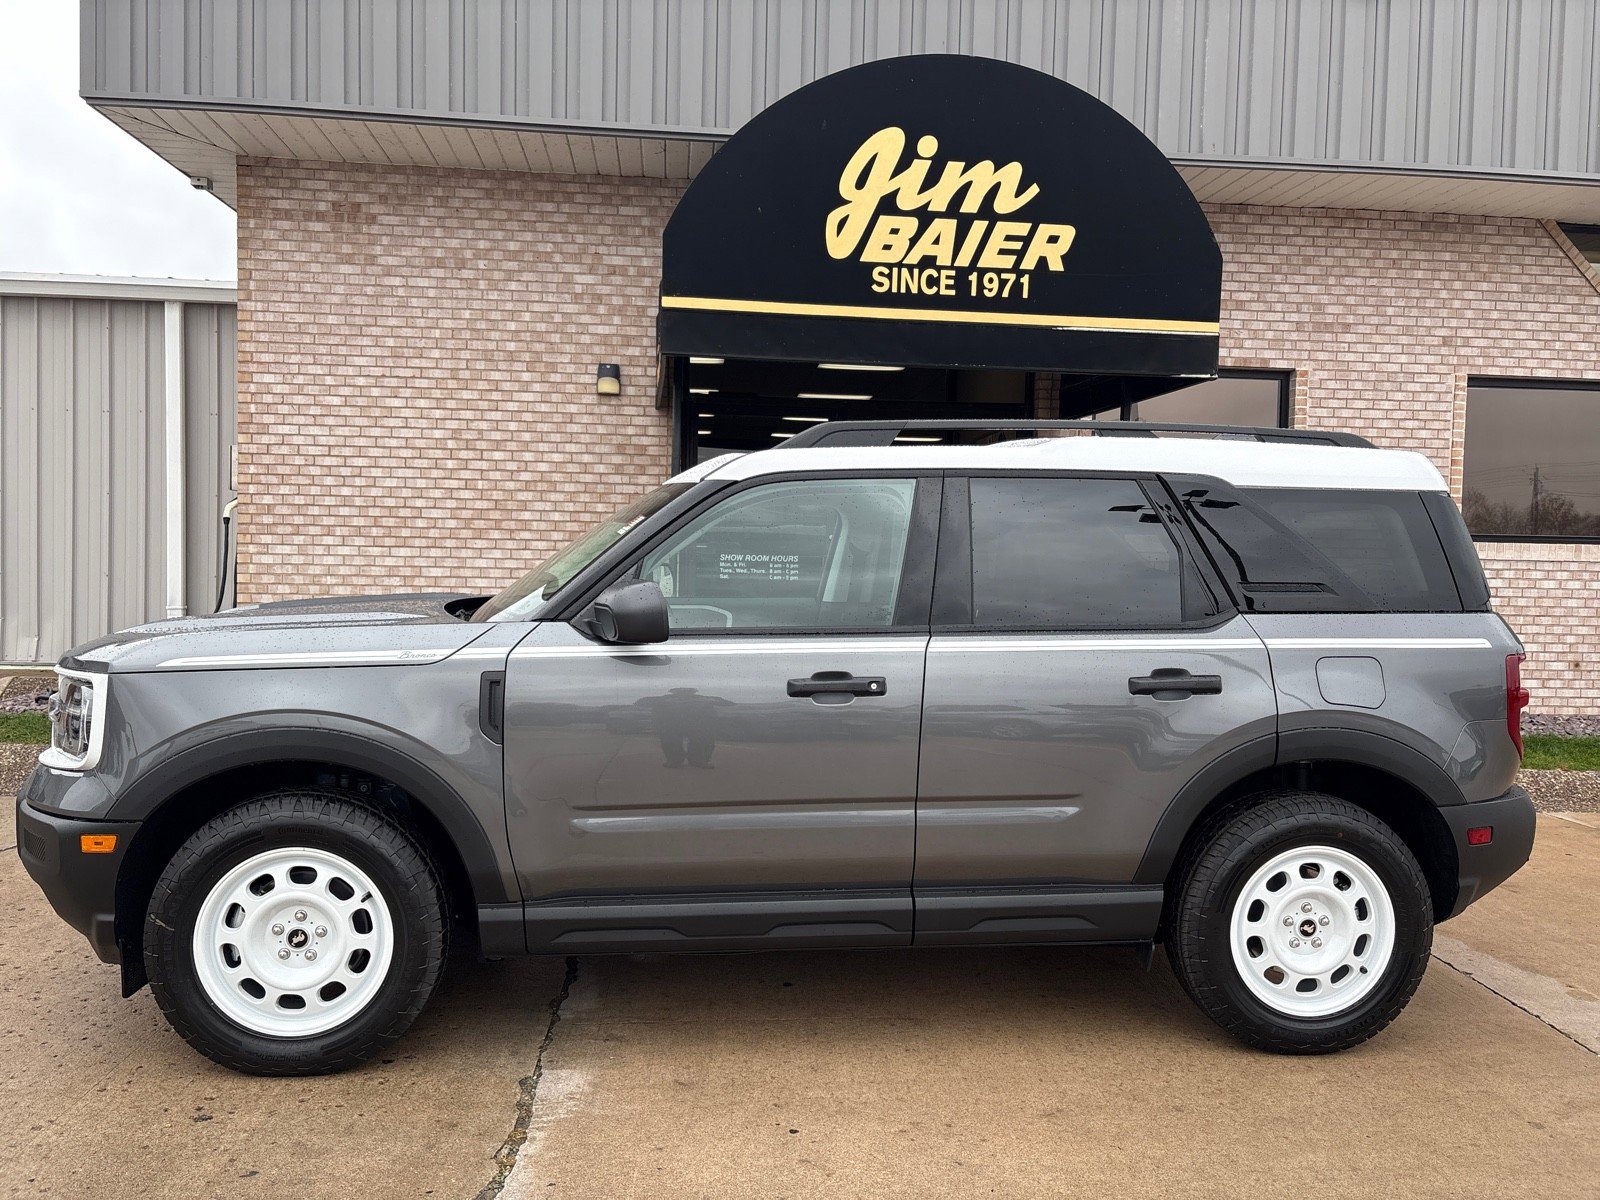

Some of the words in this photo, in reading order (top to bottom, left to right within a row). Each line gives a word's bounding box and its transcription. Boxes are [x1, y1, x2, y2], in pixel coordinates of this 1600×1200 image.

[825, 126, 1040, 260] Jim
[859, 214, 1076, 272] BAIER
[871, 266, 956, 296] SINCE
[968, 271, 1030, 299] 1971
[398, 651, 436, 659] Bronco
